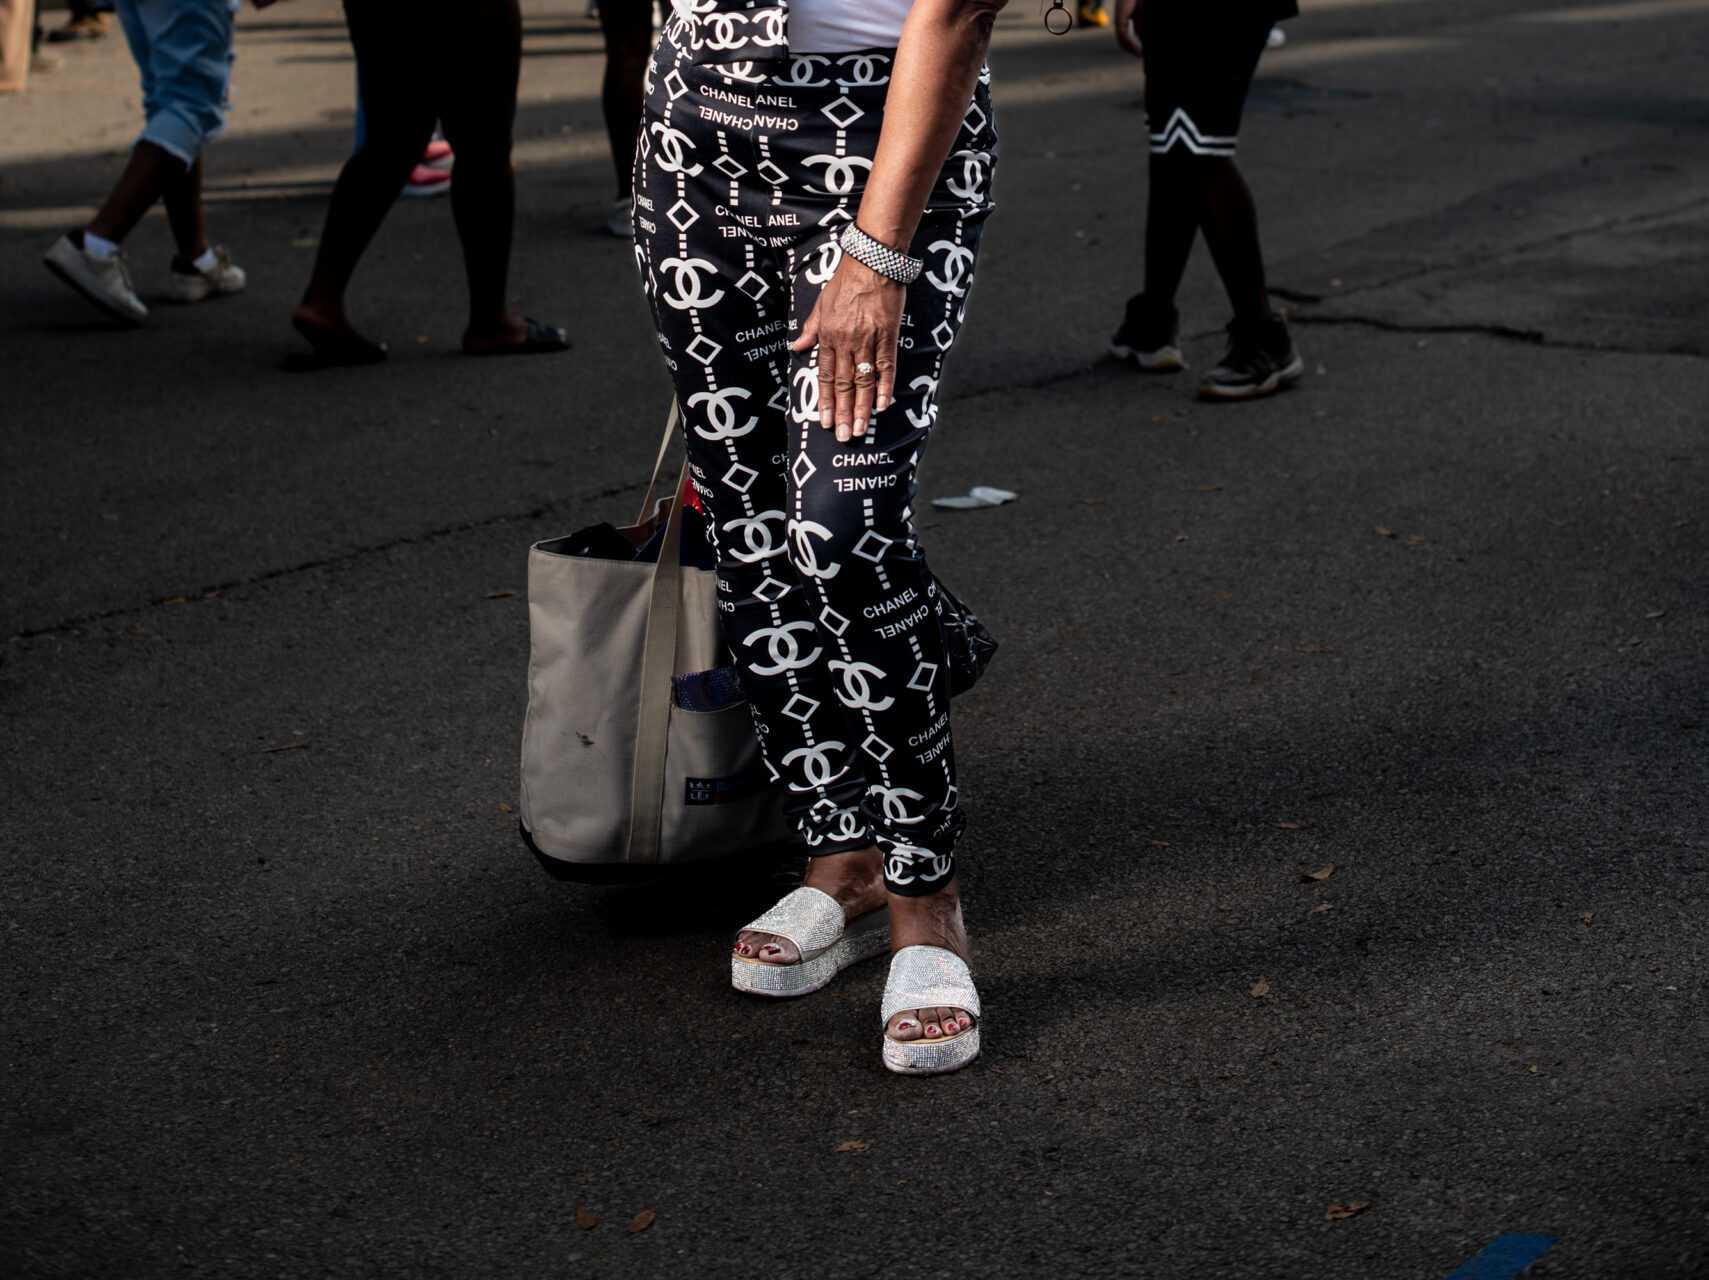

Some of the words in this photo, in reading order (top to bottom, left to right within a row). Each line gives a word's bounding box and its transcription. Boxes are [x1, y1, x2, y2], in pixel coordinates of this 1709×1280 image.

[699, 85, 755, 109] CHANEL
[698, 105, 753, 131] CHANEL
[735, 319, 788, 343] CHANE
[832, 452, 895, 468] CHANEL
[832, 474, 898, 493] CHANEL
[863, 587, 919, 619] CHANEL
[874, 604, 929, 639] CHANEL
